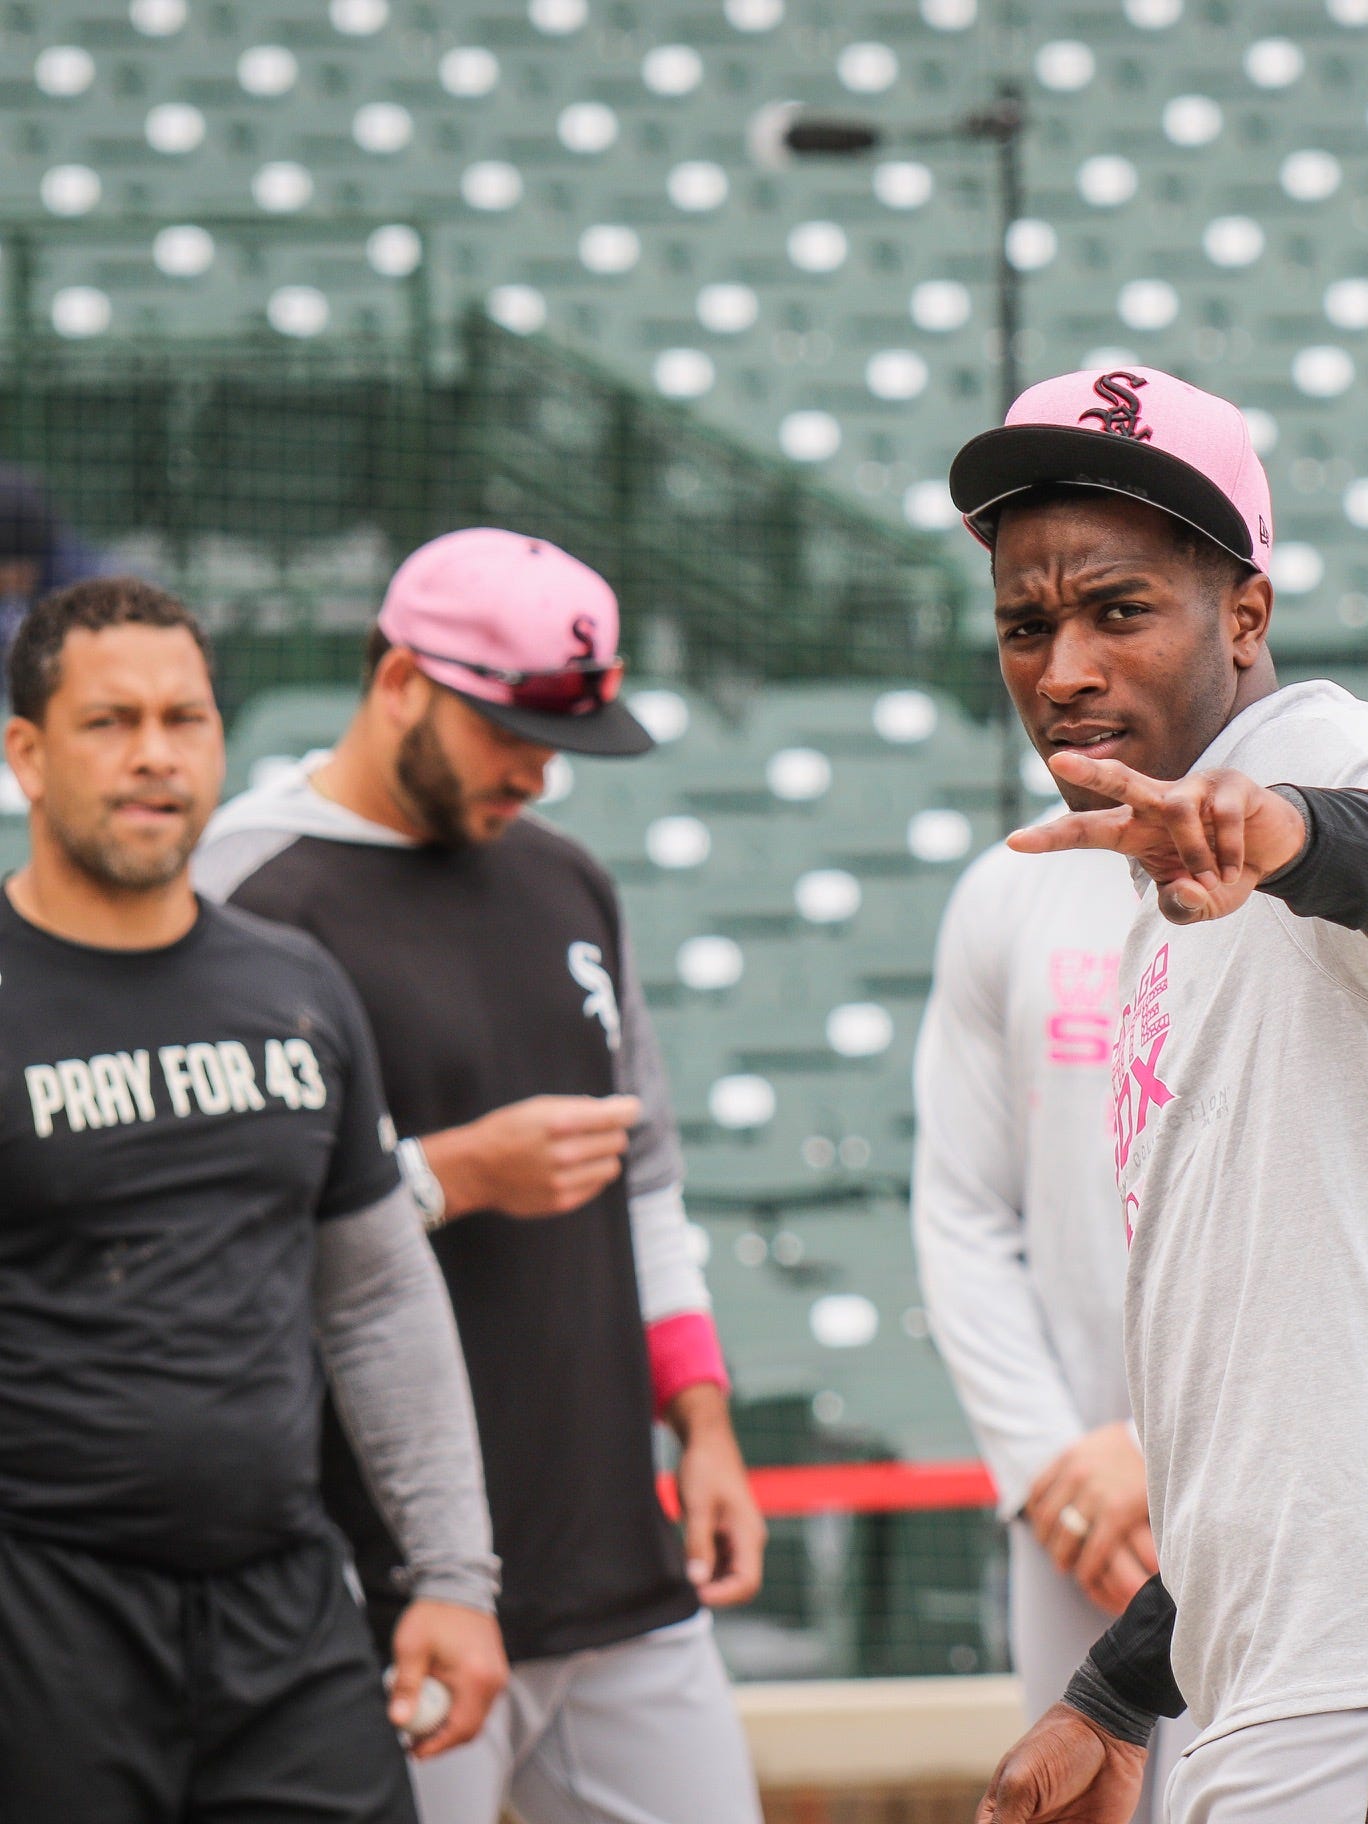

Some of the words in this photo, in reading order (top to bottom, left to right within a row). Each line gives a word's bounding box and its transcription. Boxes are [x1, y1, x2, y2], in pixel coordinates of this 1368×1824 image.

[25, 1048, 155, 1139] PRAY
[158, 1040, 266, 1118] FOR
[264, 1037, 328, 1112] 43
